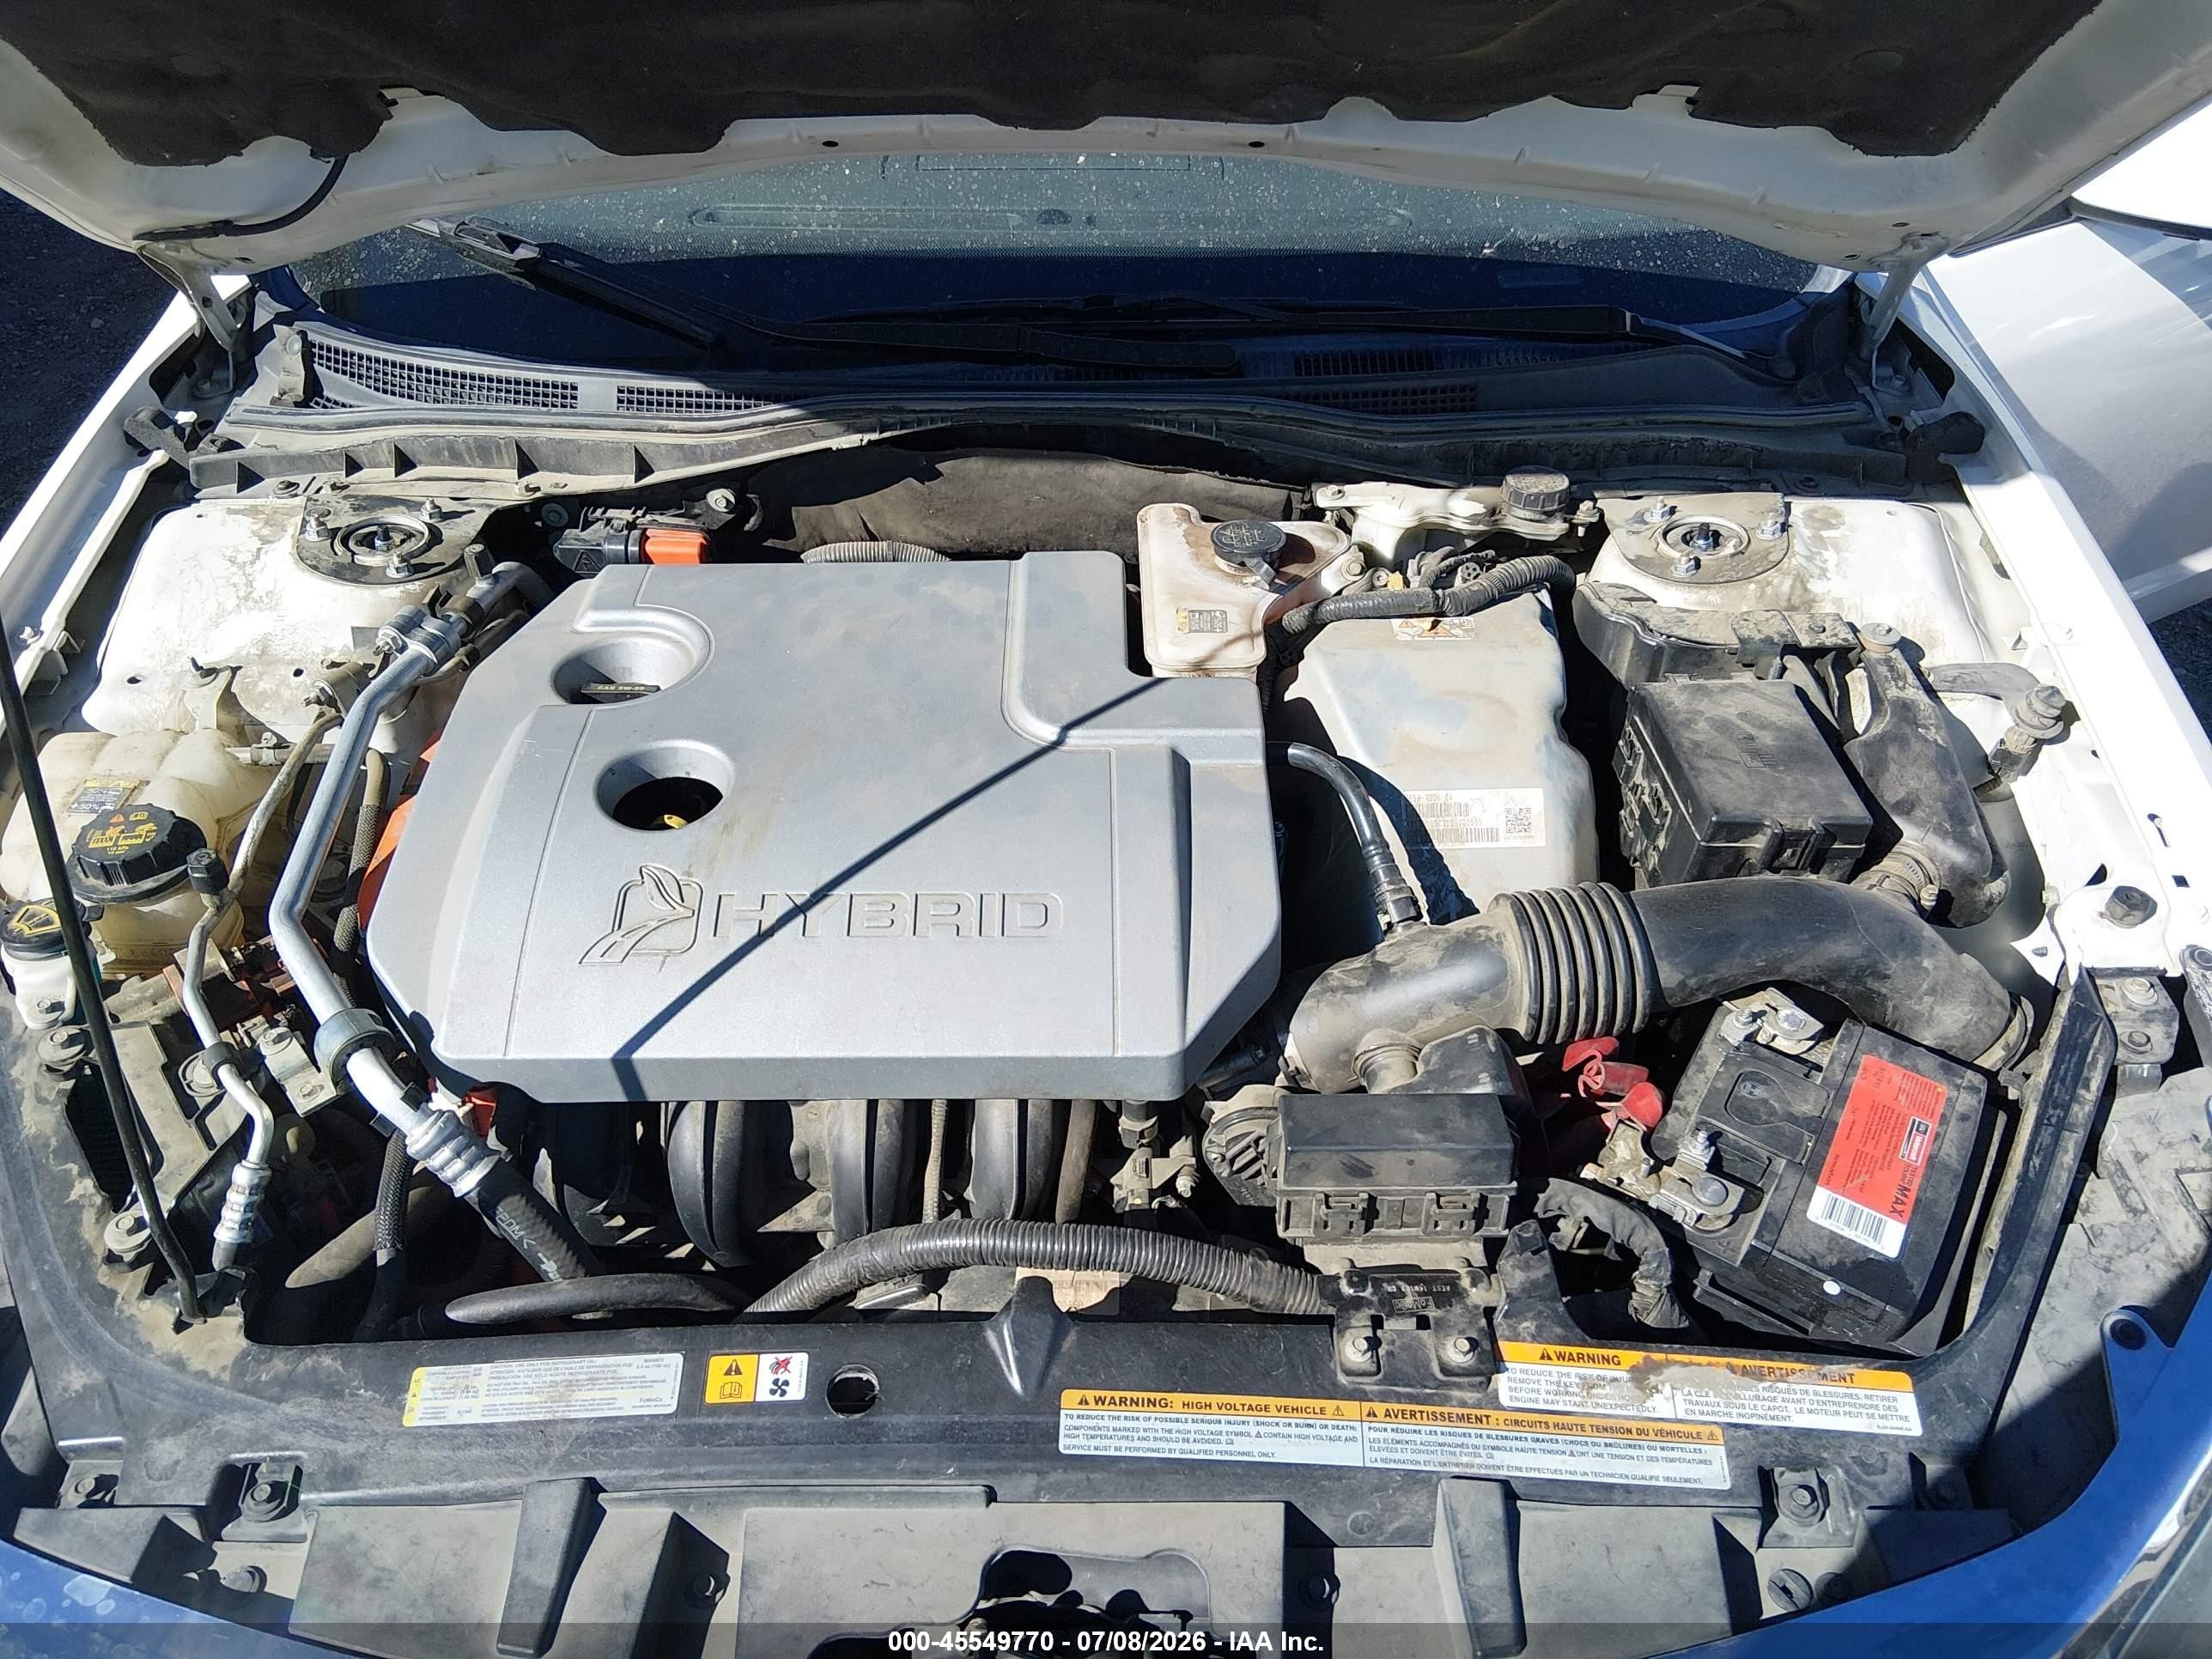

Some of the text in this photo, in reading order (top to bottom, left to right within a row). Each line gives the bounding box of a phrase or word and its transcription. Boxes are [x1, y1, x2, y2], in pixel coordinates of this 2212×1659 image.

[713, 892, 1063, 938] HYBRID
[1889, 1185, 1911, 1218] MAX
[1553, 1351, 1620, 1365] WARNING
[1507, 1376, 1542, 1385] REMOVE
[1520, 1369, 1553, 1377] REDUCE
[1741, 1364, 1855, 1384] AVERTISSMENT
[1509, 1386, 1542, 1395] BEFORE
[1545, 1389, 1588, 1399] WORKING
[1510, 1395, 1540, 1404] ENGINE
[1563, 1400, 1589, 1408] START
[1762, 1386, 1797, 1395] RISQUES
[1864, 1394, 1898, 1402] RETIRER
[1094, 1395, 1327, 1415] WARNING: HIGH VOLTAGE VEHICLE
[1683, 1399, 1721, 1407] TRAVAUX
[1761, 1405, 1790, 1413] CAPOT.
[1807, 1408, 1840, 1417] MOTEUR
[1878, 1413, 1910, 1422] METTRE
[1809, 1399, 1881, 1411] D'ENTREPRENDRE
[1384, 1408, 1491, 1425] AVERTISSEMENT
[1504, 1419, 1550, 1430] CIRCUITS
[1553, 1421, 1585, 1432] HAUTE
[1589, 1424, 1632, 1435] TENSION
[1637, 1427, 1650, 1436] DU
[1654, 1427, 1703, 1439] VÉHICULE
[1698, 1409, 1735, 1418] MARCHE
[1736, 1413, 1793, 1422] INOPINÉMENT.
[1486, 1433, 1528, 1443] BLESSURES
[1530, 1437, 1559, 1445] GRAVES
[1561, 1439, 1589, 1448] (CHOCS
[1604, 1442, 1644, 1451] BRÛLURES)
[1660, 1446, 1702, 1455] MORTELLES
[1482, 1444, 1513, 1453] SYMBOLE
[1662, 1456, 1712, 1466] TEMPÉRATURES
[1380, 1457, 1421, 1466] RÉPARATION
[1433, 1461, 1474, 1469] L'ENTRETIEN
[1506, 1464, 1523, 1473] ÊTRE
[1590, 1471, 1630, 1480] TECHNICIEN
[1662, 1475, 1703, 1484] SEULEMENT.
